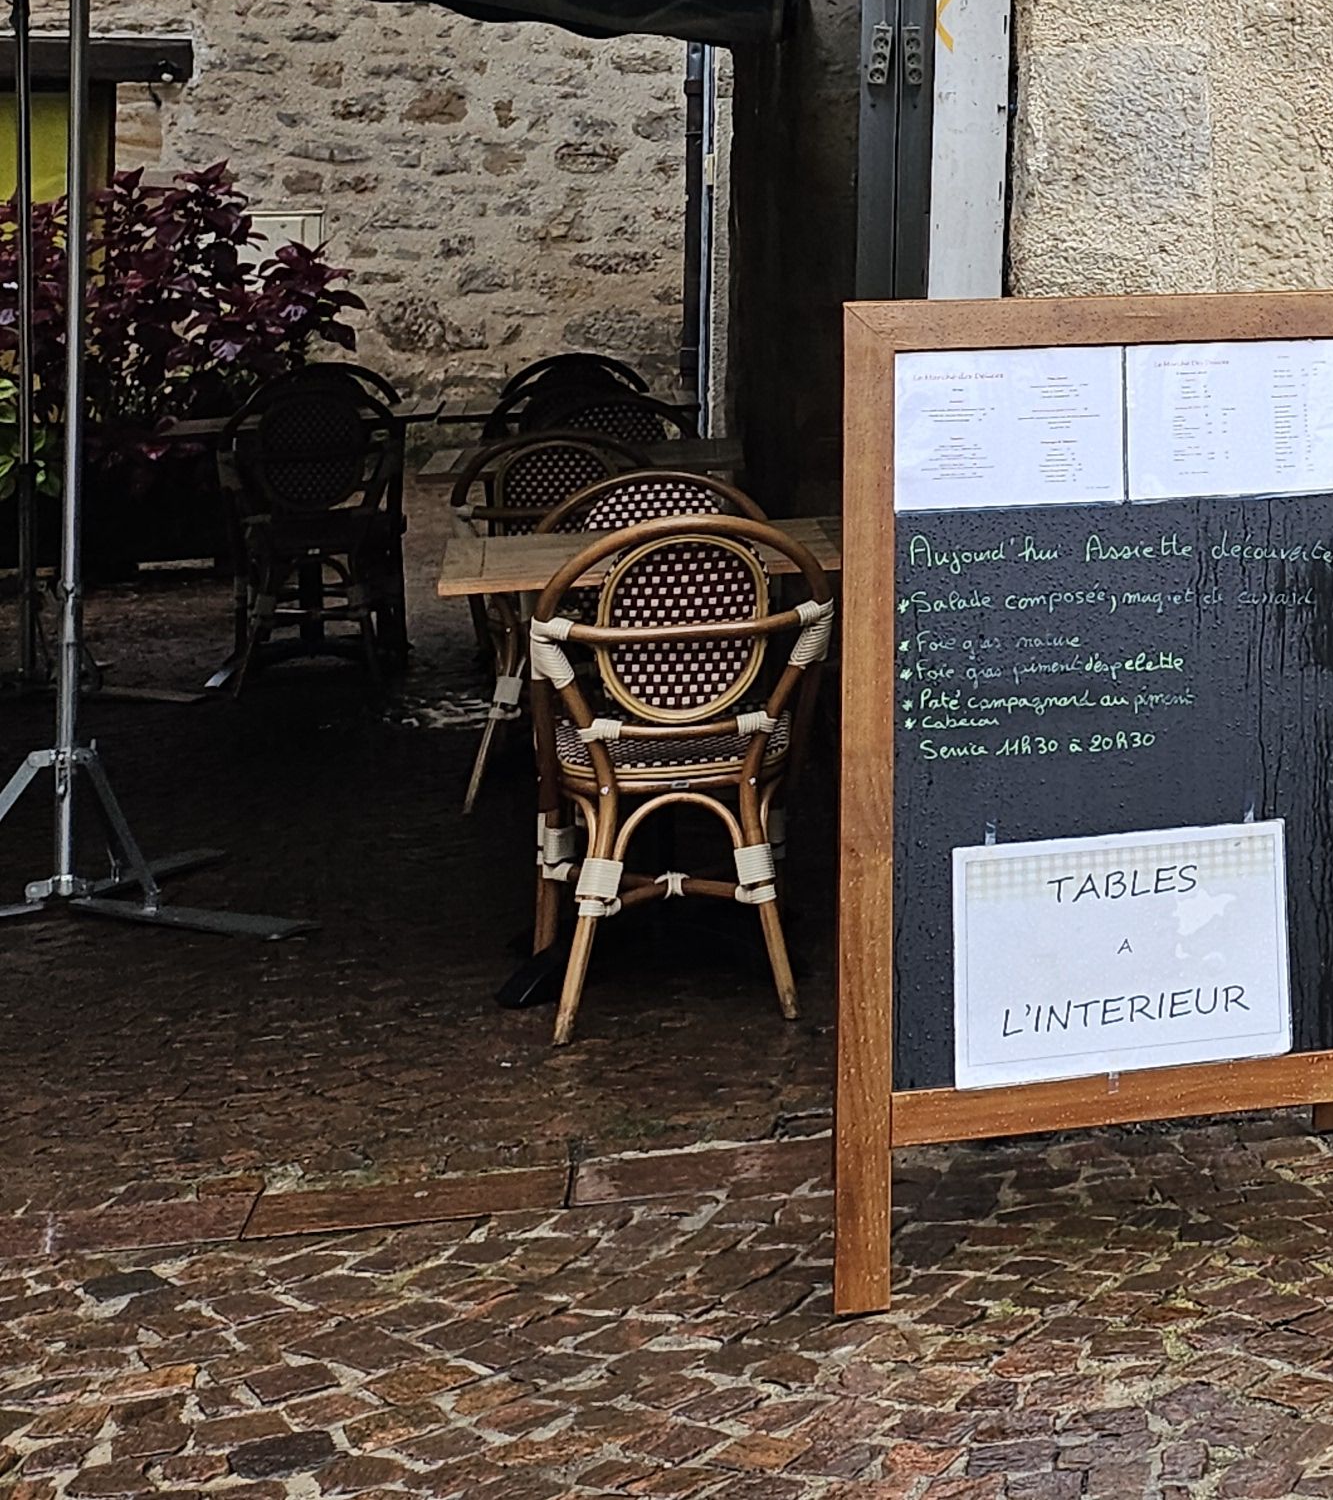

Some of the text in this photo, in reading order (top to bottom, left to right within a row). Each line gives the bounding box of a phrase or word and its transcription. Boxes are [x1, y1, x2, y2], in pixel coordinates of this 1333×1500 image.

[1085, 533, 1192, 563] Assiette
[1211, 529, 1333, 563] découverte
[911, 590, 993, 614] Salade
[916, 629, 956, 652] Foie
[916, 658, 955, 681] Foie
[966, 666, 1002, 689] gras
[1100, 694, 1129, 707] au
[919, 739, 988, 760] Service
[1047, 864, 1198, 903] TABLES
[1117, 938, 1134, 954] A
[1002, 985, 1250, 1038] L'INTERIEUR
